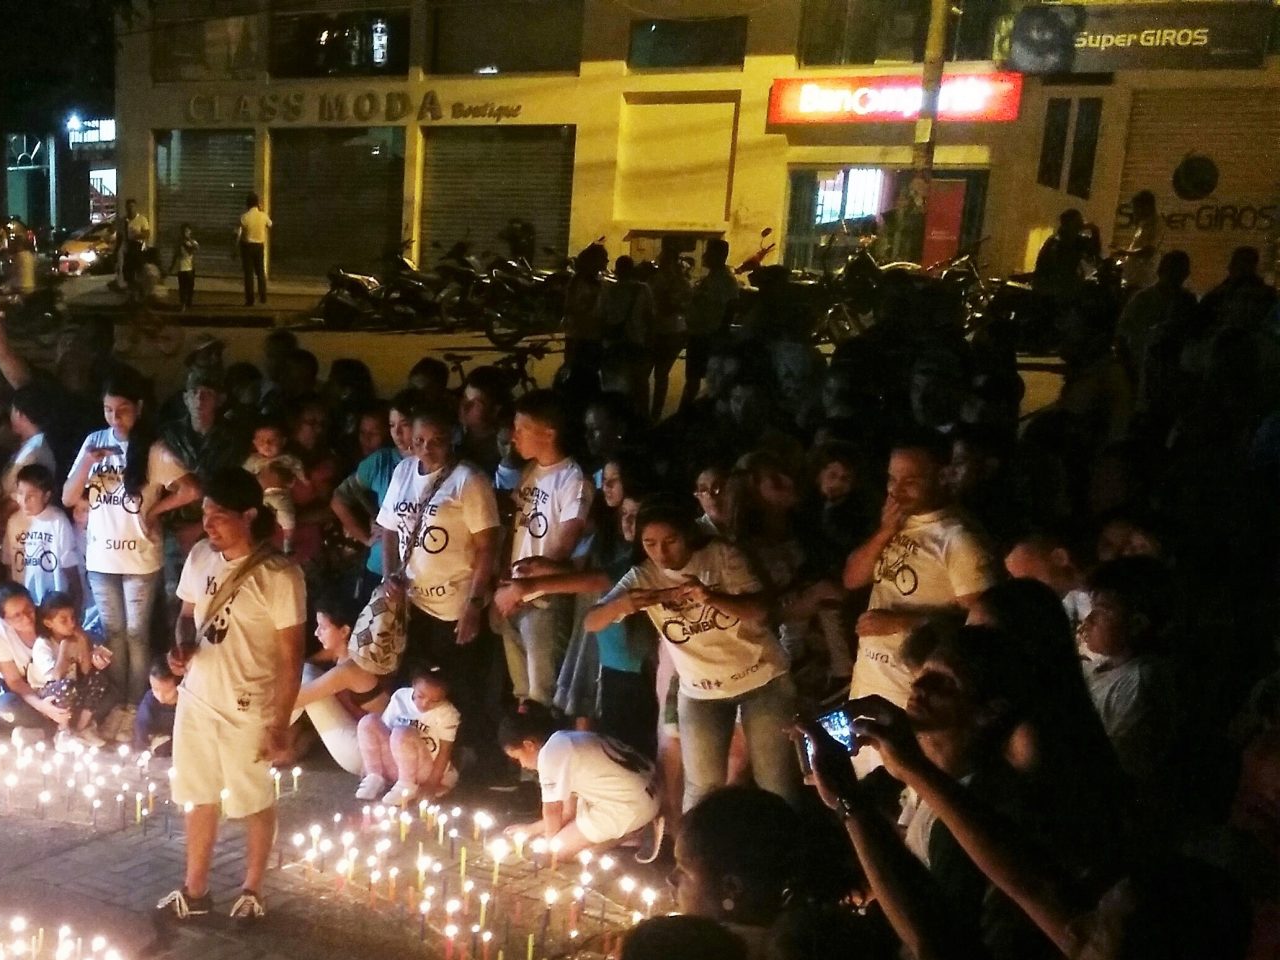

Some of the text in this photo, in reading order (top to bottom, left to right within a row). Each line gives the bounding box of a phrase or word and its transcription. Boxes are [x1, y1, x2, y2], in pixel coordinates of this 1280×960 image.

[183, 90, 523, 124] CLASS MODA Boutique
[105, 539, 137, 551] sura
